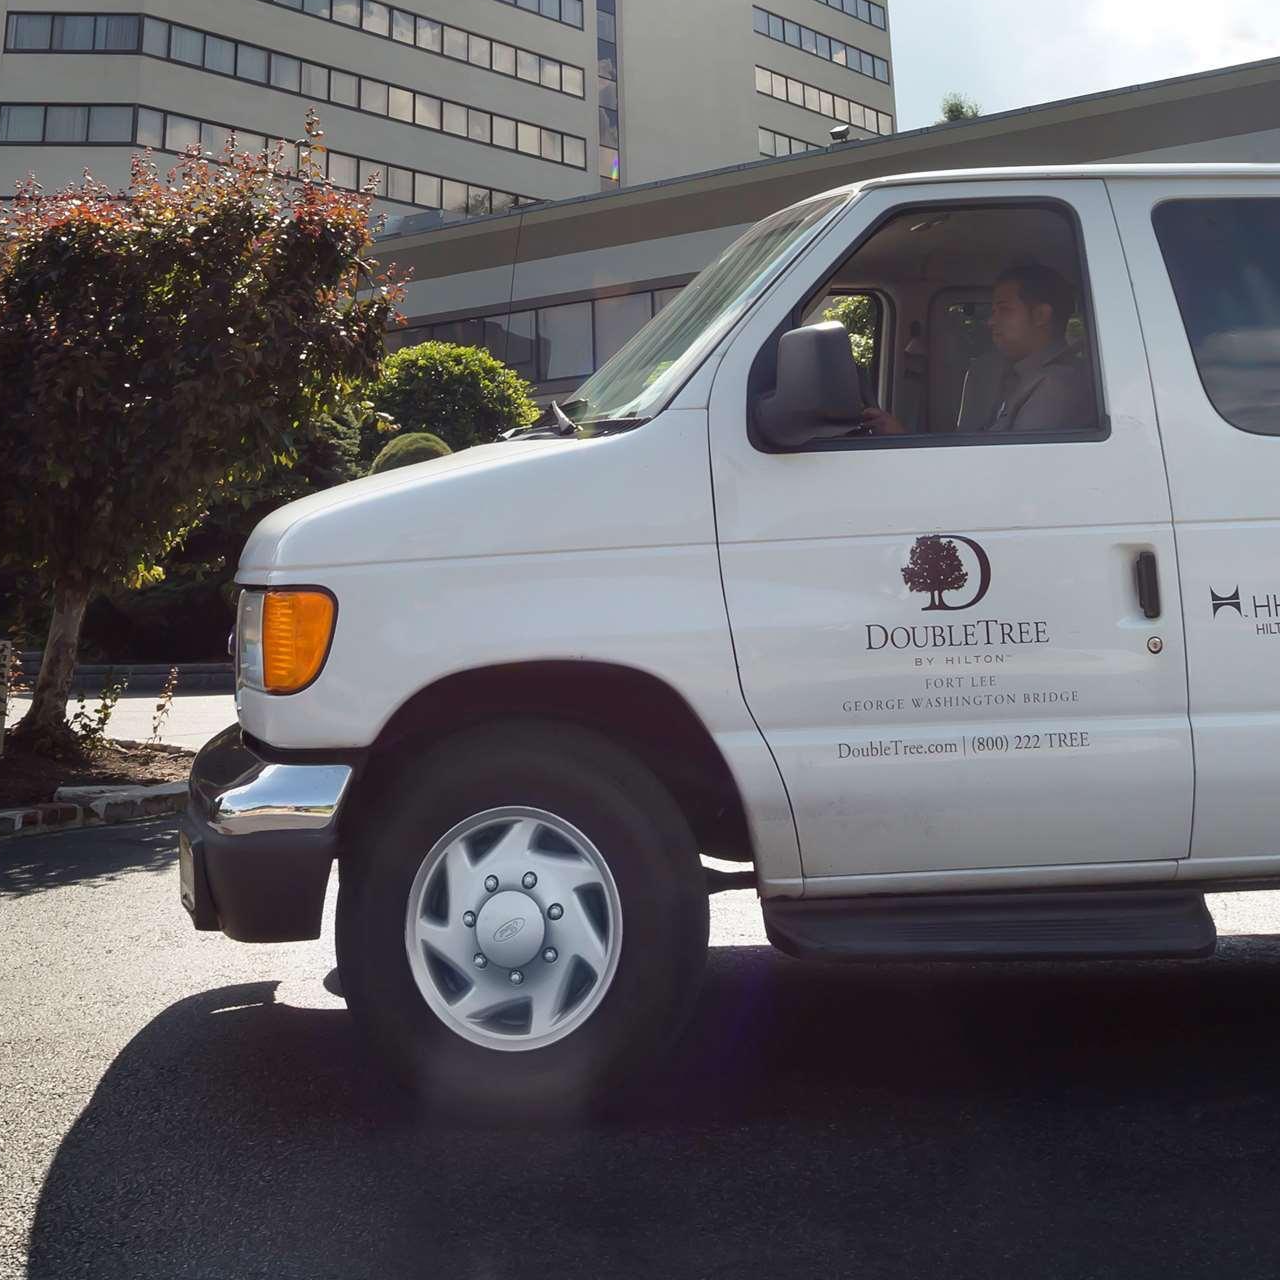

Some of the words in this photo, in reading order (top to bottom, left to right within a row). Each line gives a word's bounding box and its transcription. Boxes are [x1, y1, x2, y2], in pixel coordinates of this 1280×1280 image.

[914, 657, 936, 667] BY
[925, 677, 963, 689] FORT
[971, 675, 997, 688] LEE
[842, 699, 904, 712] GEORGE
[911, 694, 1016, 708] WASHINGTON
[1023, 691, 1079, 704] BRIDGE
[838, 740, 957, 759] DoubleTree.com
[971, 735, 1010, 754] (800)
[1014, 734, 1041, 750] 222
[1045, 731, 1090, 748] TREE
